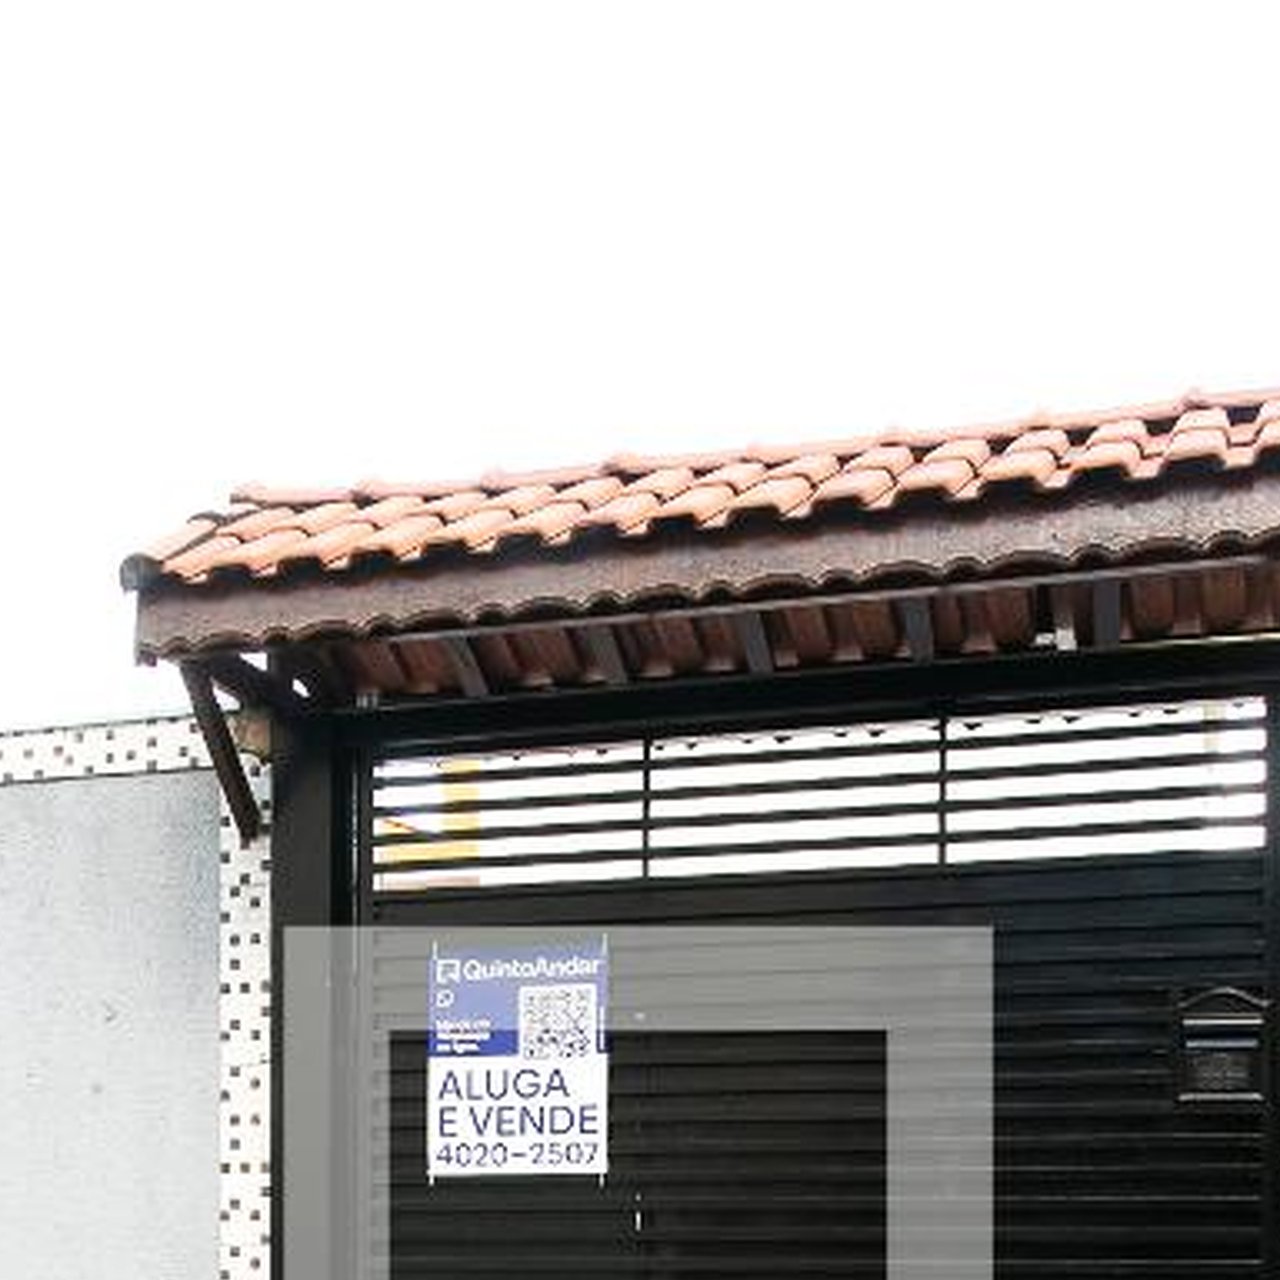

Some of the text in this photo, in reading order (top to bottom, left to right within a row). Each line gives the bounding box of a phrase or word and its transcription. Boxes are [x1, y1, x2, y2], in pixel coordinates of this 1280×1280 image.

[463, 956, 600, 980] QuintoAndar
[438, 1067, 571, 1101] ALUGA
[439, 1102, 599, 1138] E VENDE
[435, 1141, 599, 1167] 4020-2507
